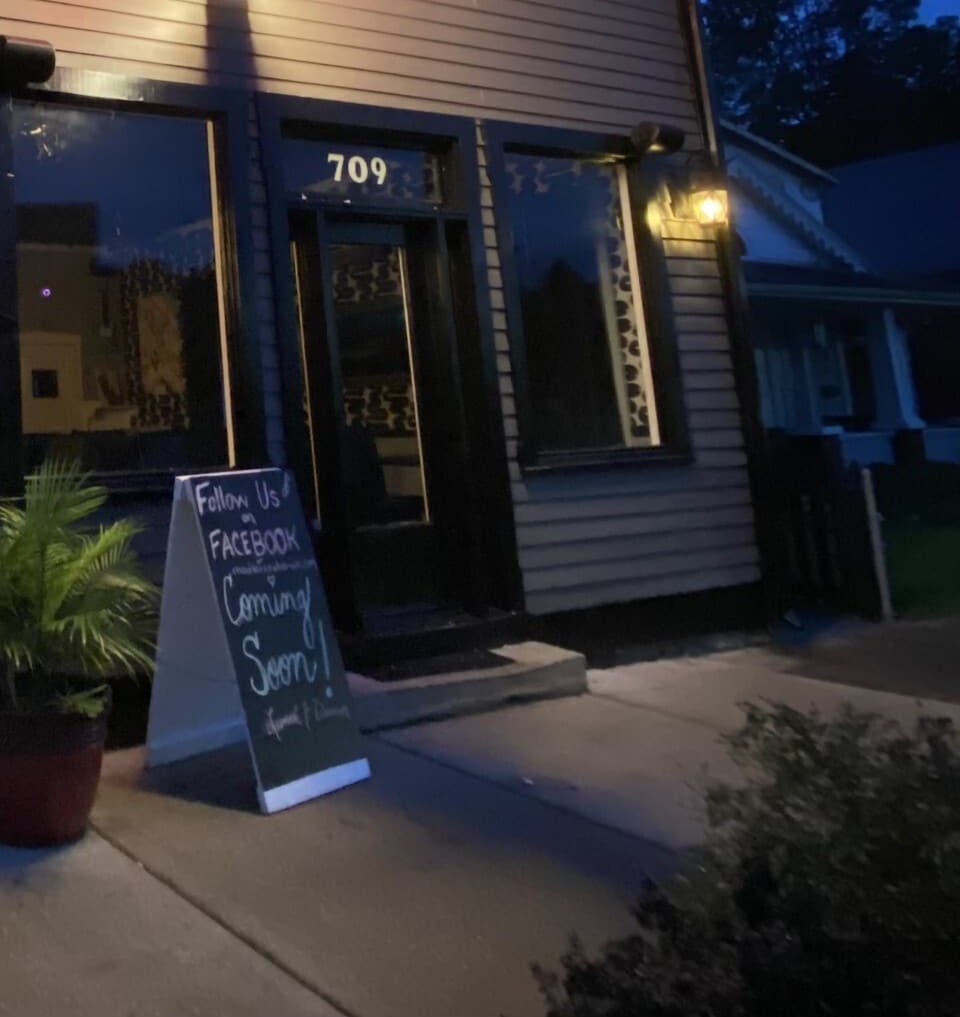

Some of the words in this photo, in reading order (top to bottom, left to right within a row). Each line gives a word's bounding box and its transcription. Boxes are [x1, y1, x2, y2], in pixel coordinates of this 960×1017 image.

[327, 152, 387, 185] 709
[195, 481, 249, 516] Follow
[208, 525, 301, 561] FACEBOOK
[223, 575, 312, 649] Coming
[242, 619, 333, 698] Soon!
